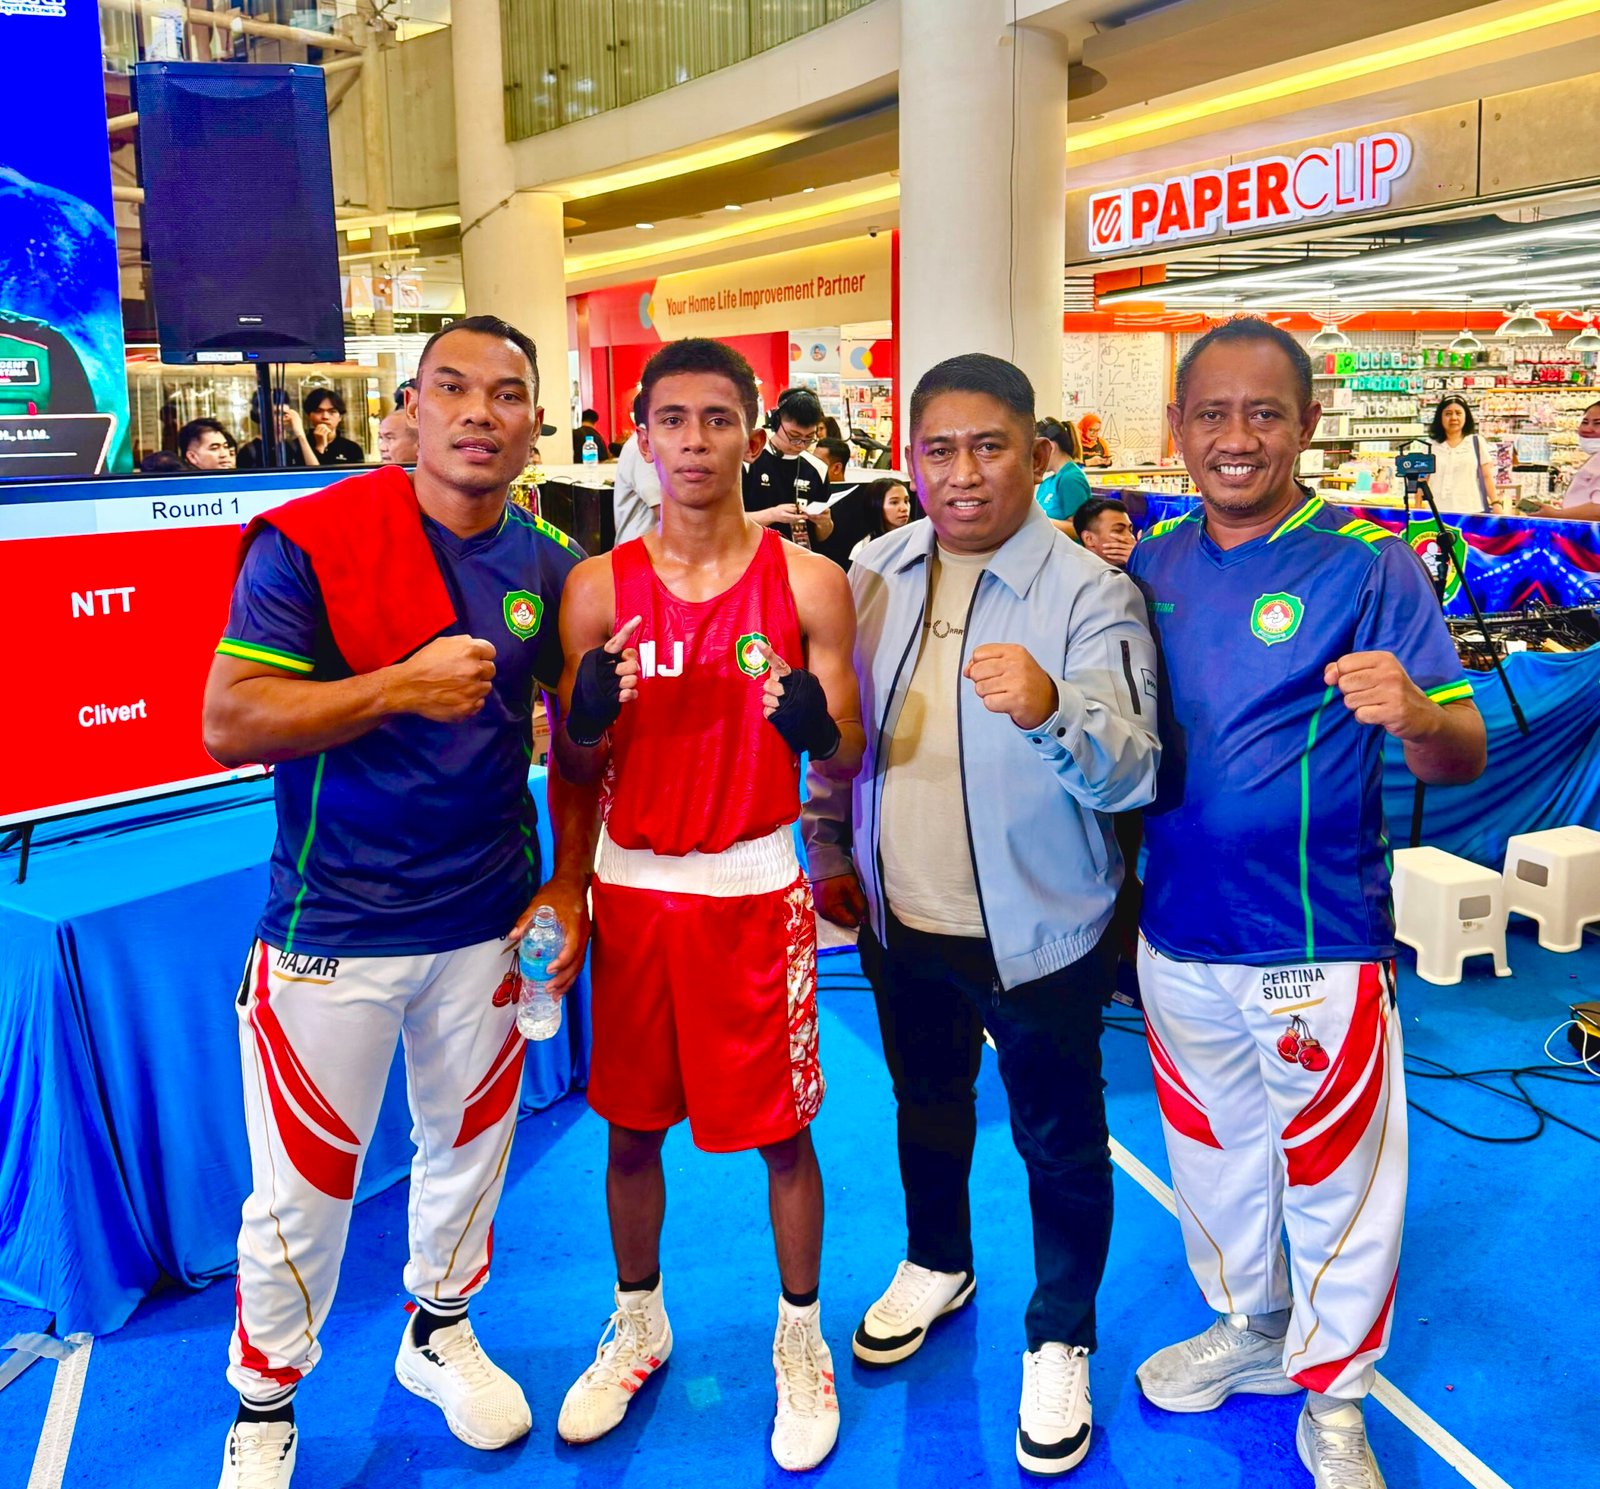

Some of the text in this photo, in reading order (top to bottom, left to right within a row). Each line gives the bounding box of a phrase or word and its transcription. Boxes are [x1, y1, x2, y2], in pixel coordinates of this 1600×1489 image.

[1131, 138, 1398, 240] PAPERCLIP
[666, 274, 866, 316] Your Home Life Improvement Partner
[152, 498, 239, 519] Round 1
[71, 586, 136, 618] NTT
[78, 698, 147, 728] Clivert
[277, 950, 340, 978] HAJAR
[1262, 967, 1326, 985] PERTINA
[1263, 984, 1311, 1000] SULUT
